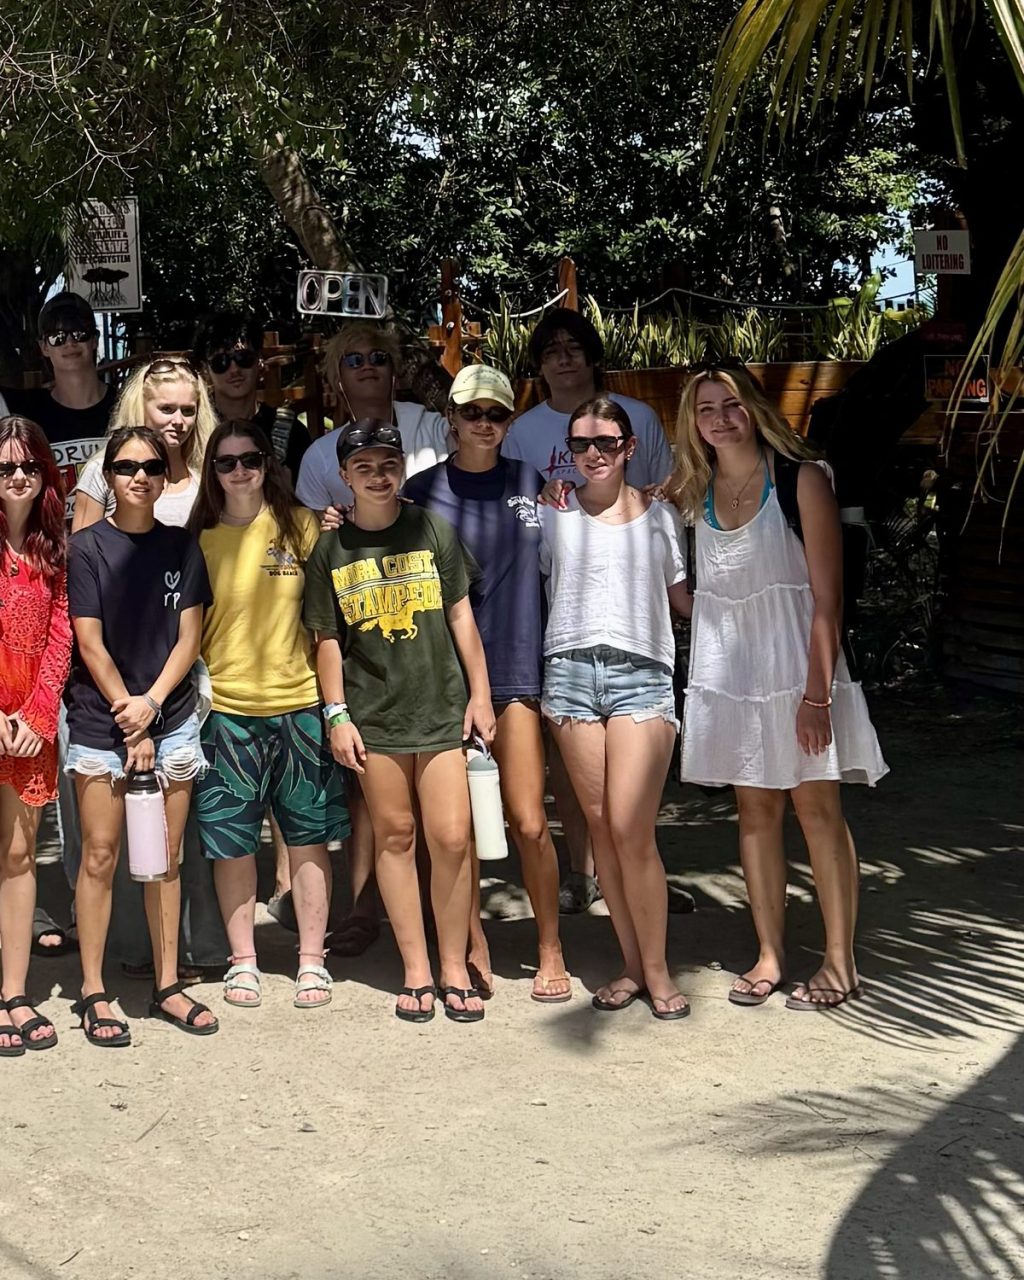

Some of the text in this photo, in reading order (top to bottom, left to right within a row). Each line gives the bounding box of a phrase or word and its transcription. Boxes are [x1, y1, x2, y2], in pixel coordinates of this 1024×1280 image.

[936, 234, 948, 251] NO
[921, 253, 964, 270] LOITERING
[302, 273, 385, 316] OPEN
